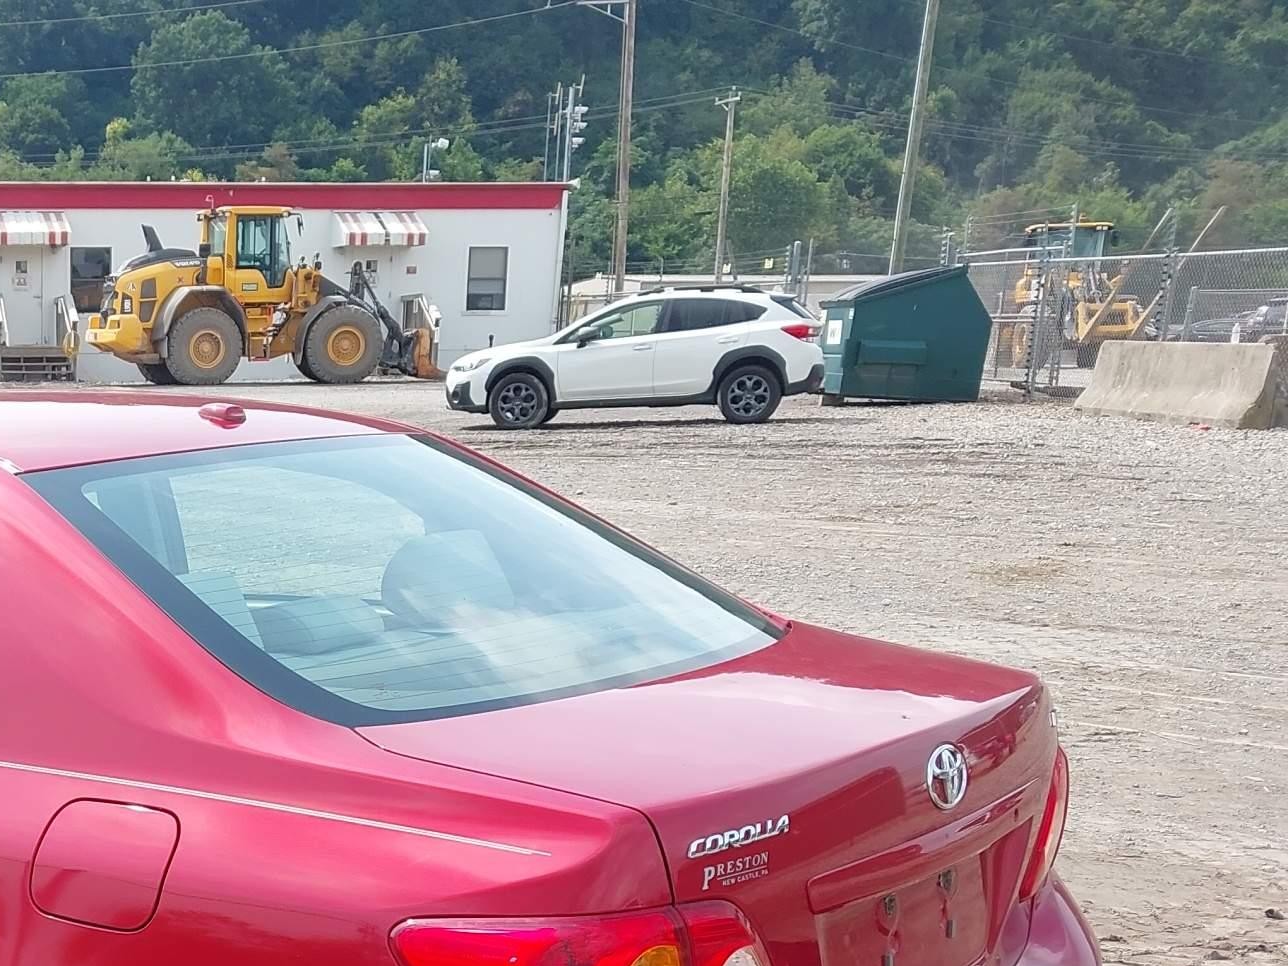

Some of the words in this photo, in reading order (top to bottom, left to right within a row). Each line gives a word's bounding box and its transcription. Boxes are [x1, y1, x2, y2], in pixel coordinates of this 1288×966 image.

[687, 814, 789, 858] COROLLA
[702, 851, 769, 891] PRESTON
[722, 877, 735, 886] NEW
